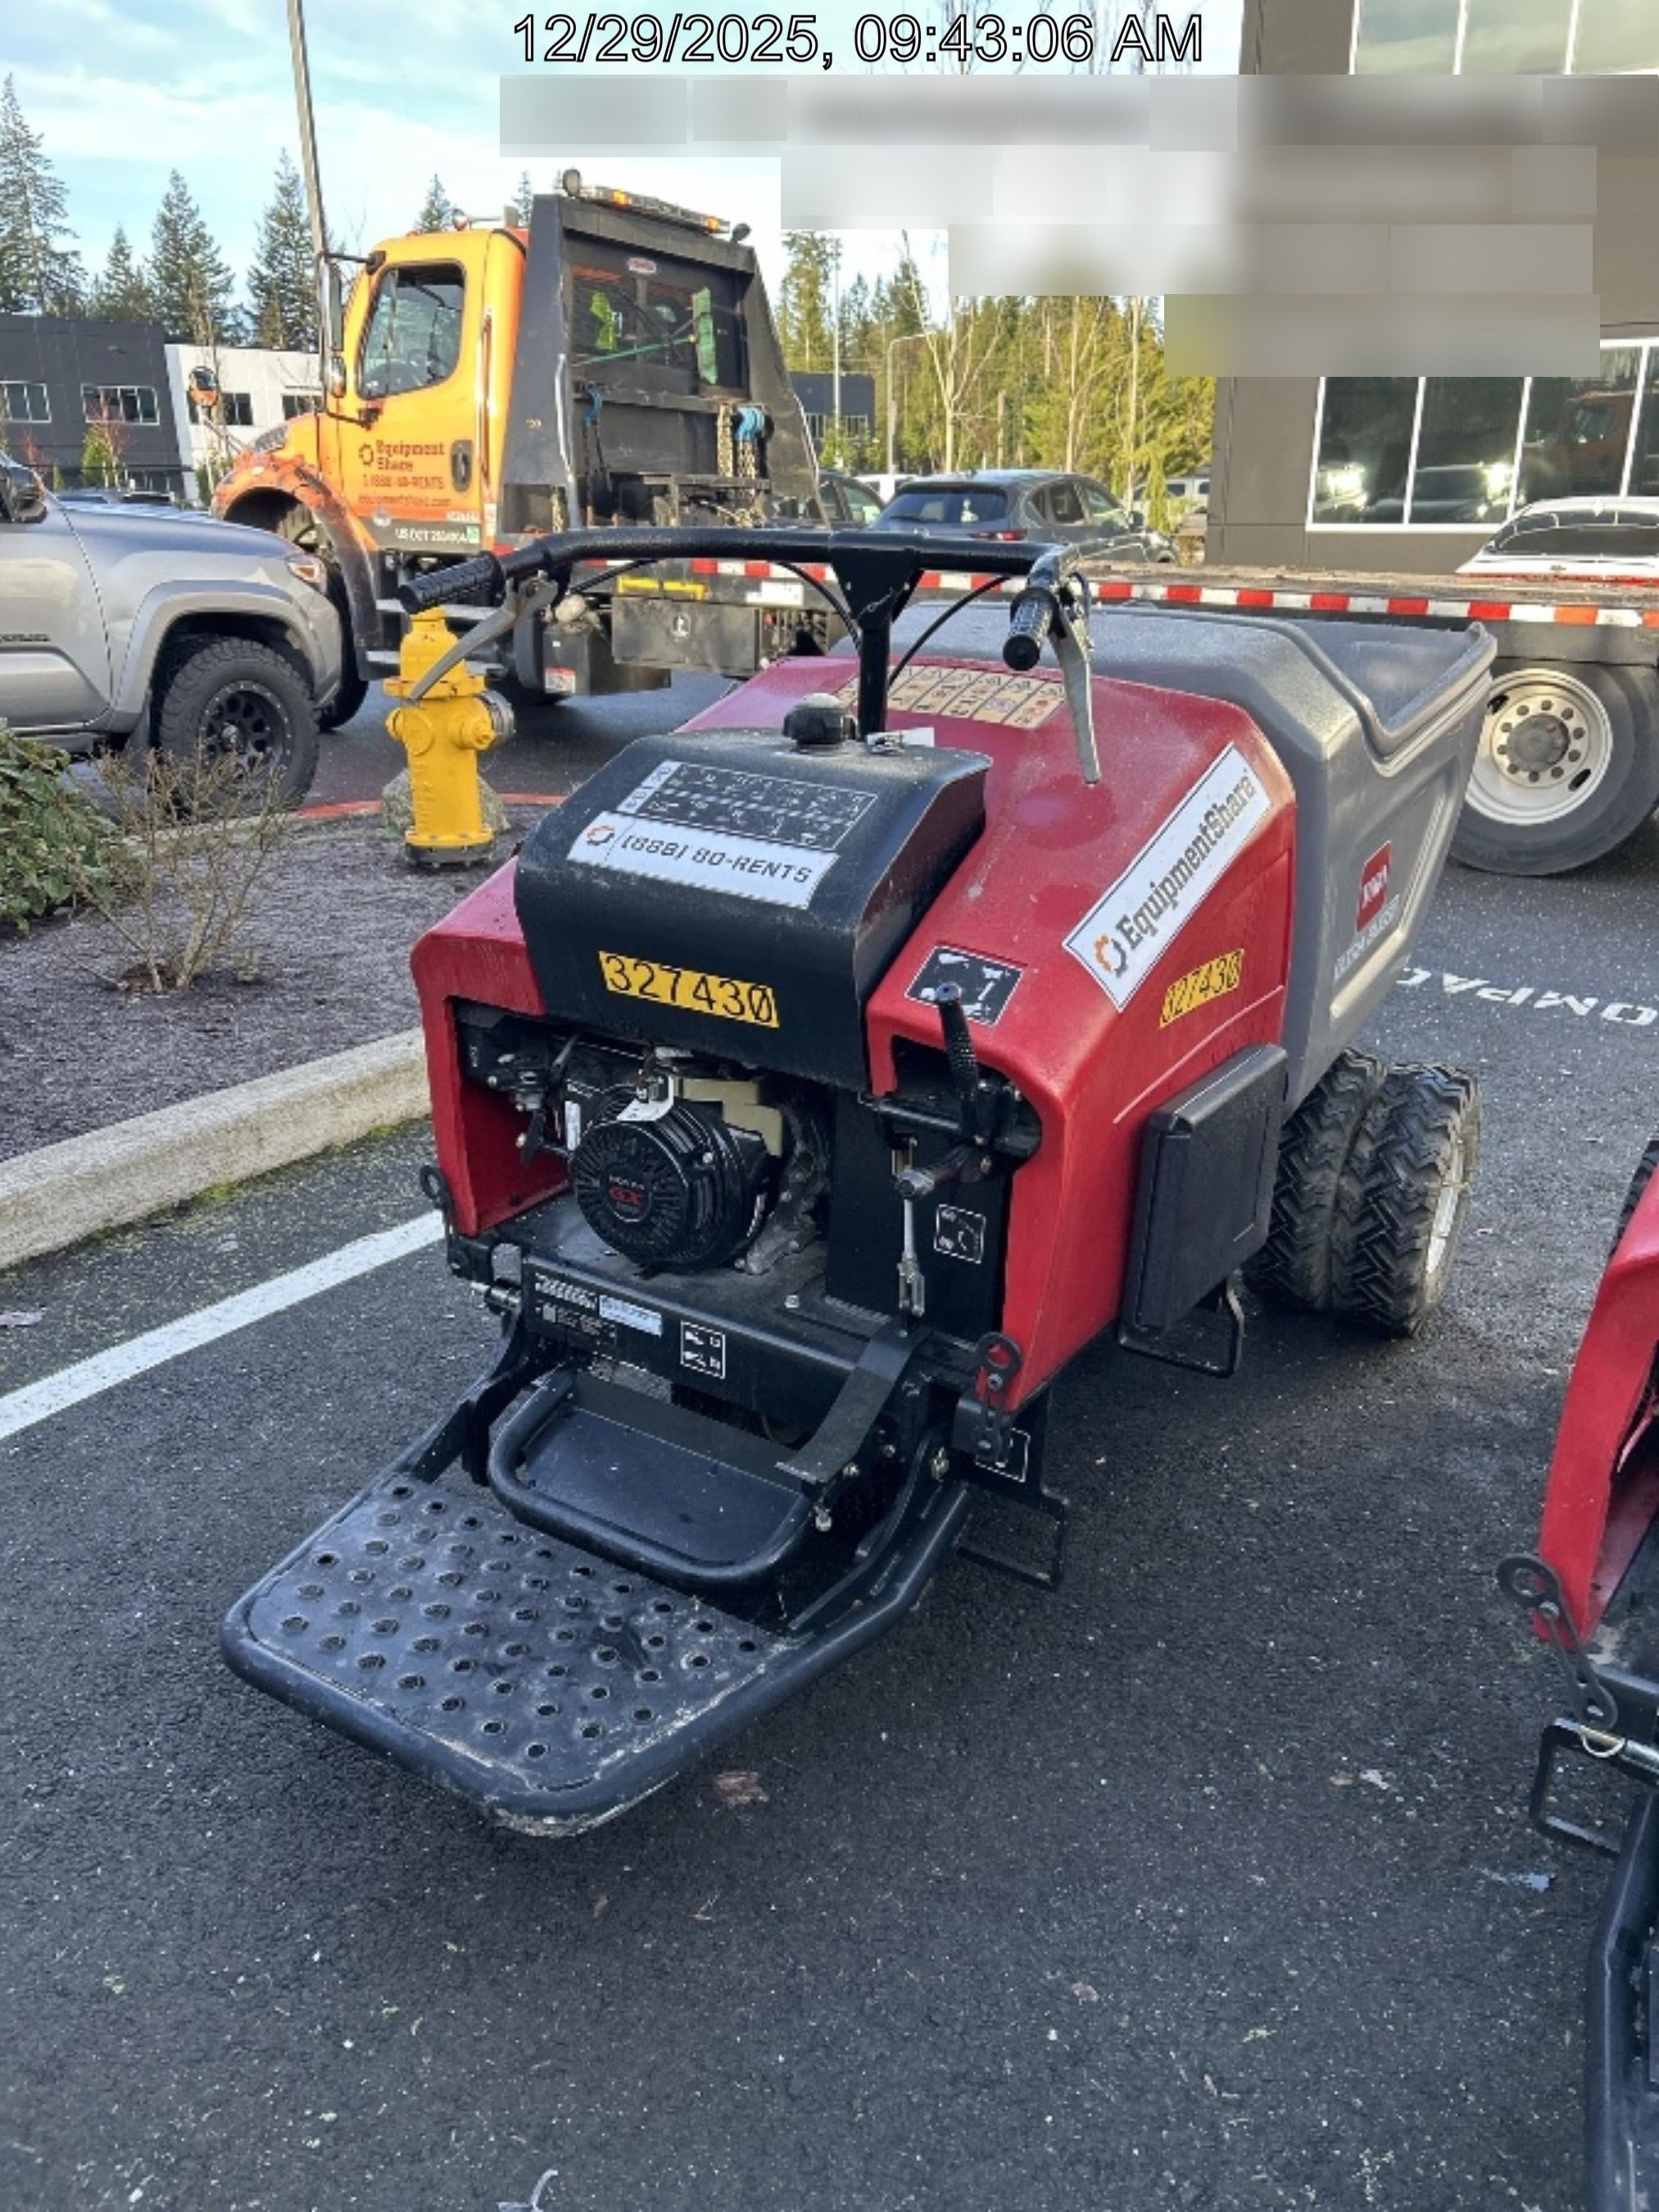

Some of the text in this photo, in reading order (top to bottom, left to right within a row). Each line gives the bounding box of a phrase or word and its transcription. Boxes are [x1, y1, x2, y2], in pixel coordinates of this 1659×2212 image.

[691, 850, 812, 883] 80-RENTS
[1116, 776, 1257, 951] EquipmentShare
[605, 955, 773, 1022] 327430
